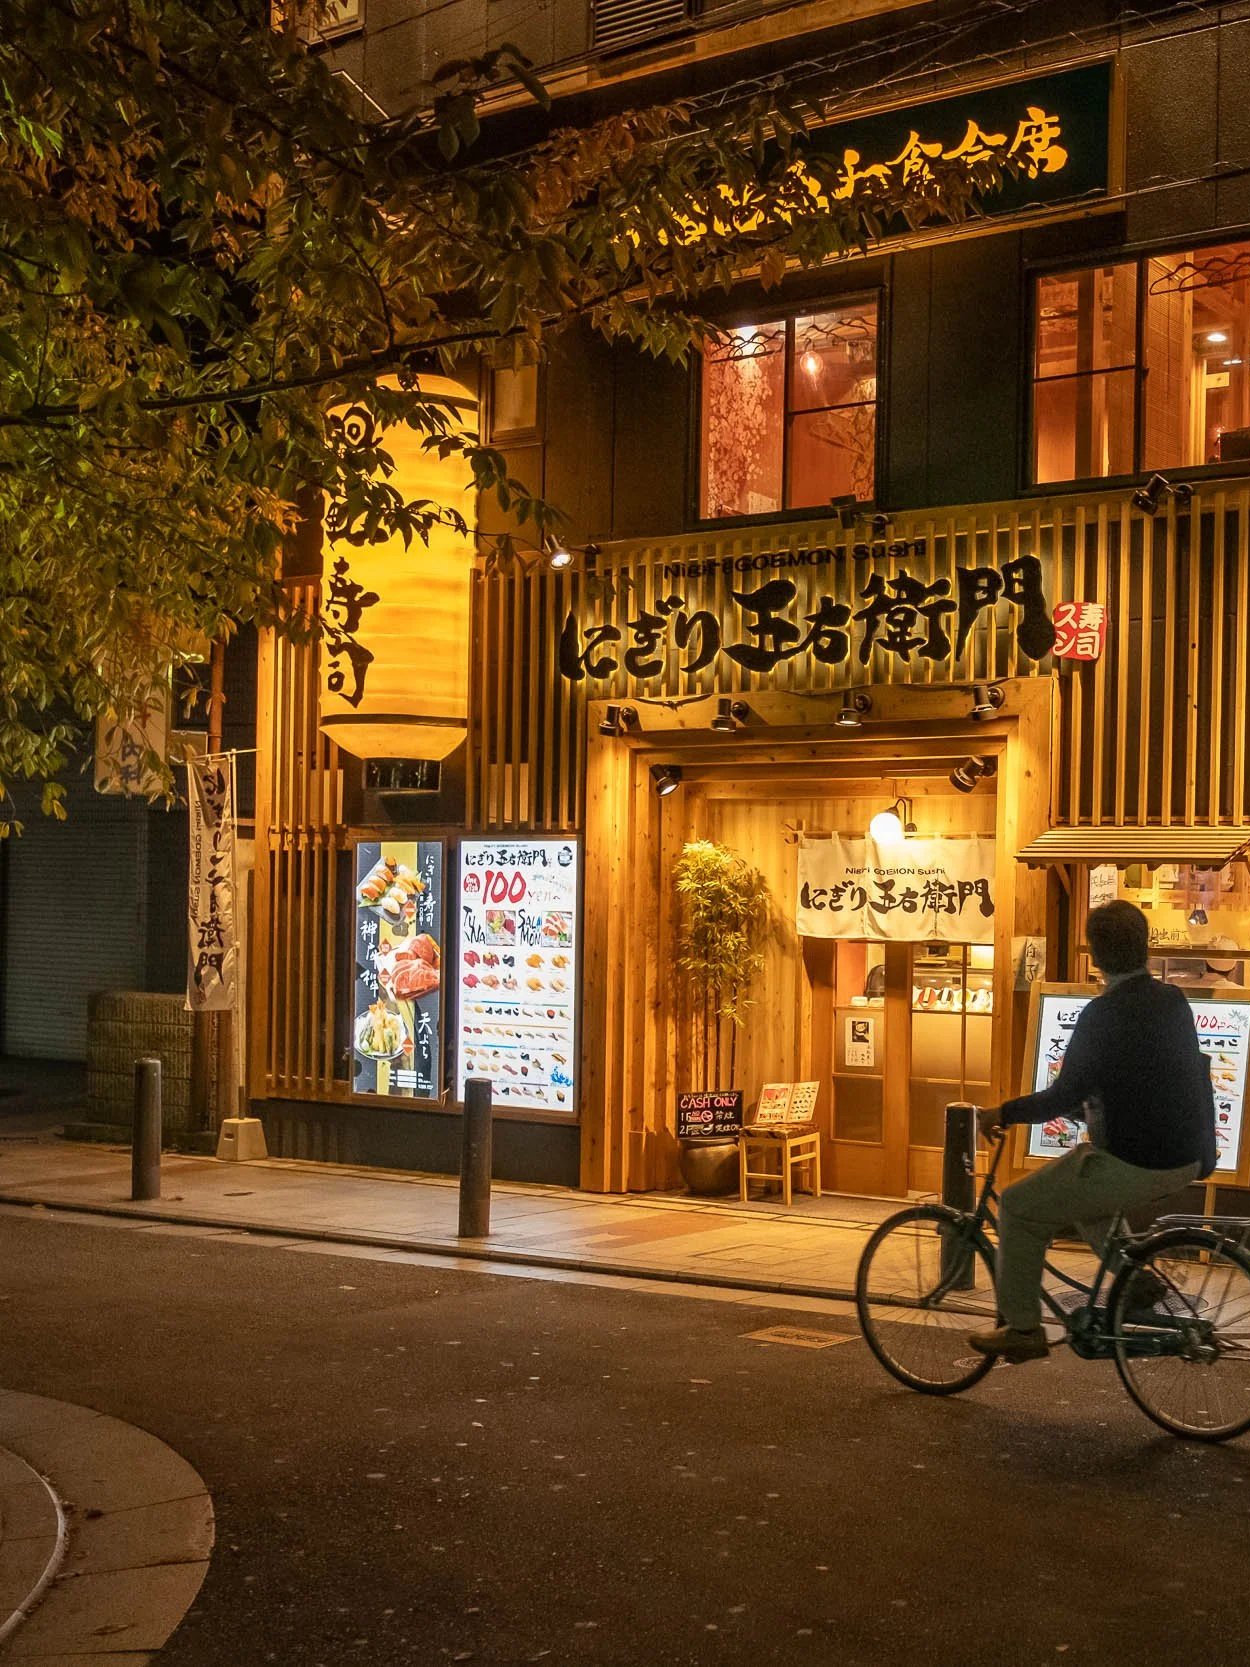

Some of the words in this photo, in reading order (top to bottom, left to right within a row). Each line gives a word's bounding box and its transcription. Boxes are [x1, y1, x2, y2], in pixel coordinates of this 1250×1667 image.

[560, 554, 1057, 681] にぎり五右衛門
[1053, 603, 1077, 656] スシ
[1076, 602, 1104, 659] 寿司
[465, 849, 548, 868] にぎり五右衛門
[917, 866, 946, 875] Sushi
[482, 870, 527, 905] 100
[800, 878, 995, 918] にぎり五右衛門
[1057, 1008, 1080, 1022] にぎ
[680, 1096, 711, 1109] CASH
[713, 1095, 738, 1108] ONLY
